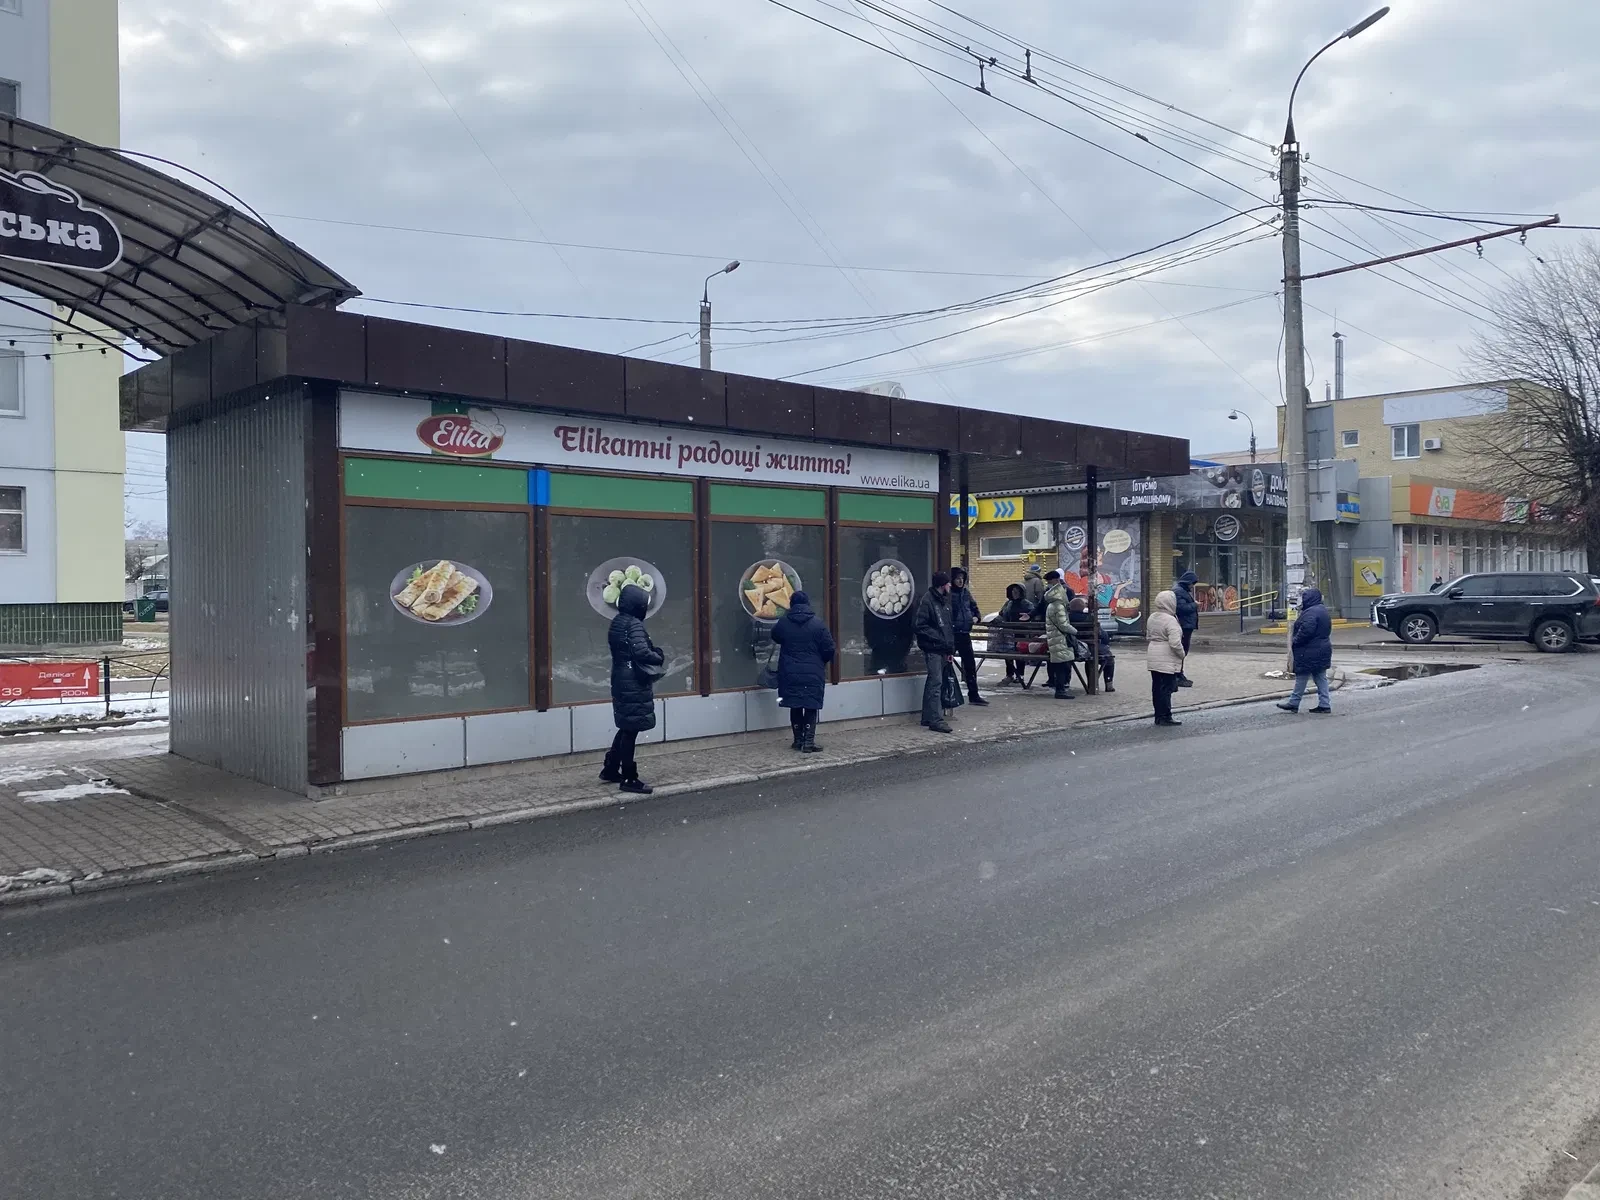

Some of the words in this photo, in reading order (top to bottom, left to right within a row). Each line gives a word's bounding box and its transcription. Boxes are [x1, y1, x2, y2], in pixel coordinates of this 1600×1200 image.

[432, 420, 491, 450] Elika
[677, 439, 760, 473] радощі
[766, 452, 852, 475] життя!
[860, 474, 930, 489] www.elika.ua
[1132, 479, 1157, 494] Готуємо
[1121, 494, 1171, 506] по-домашньому
[1, 687, 23, 697] 33
[60, 689, 89, 698] 200м
